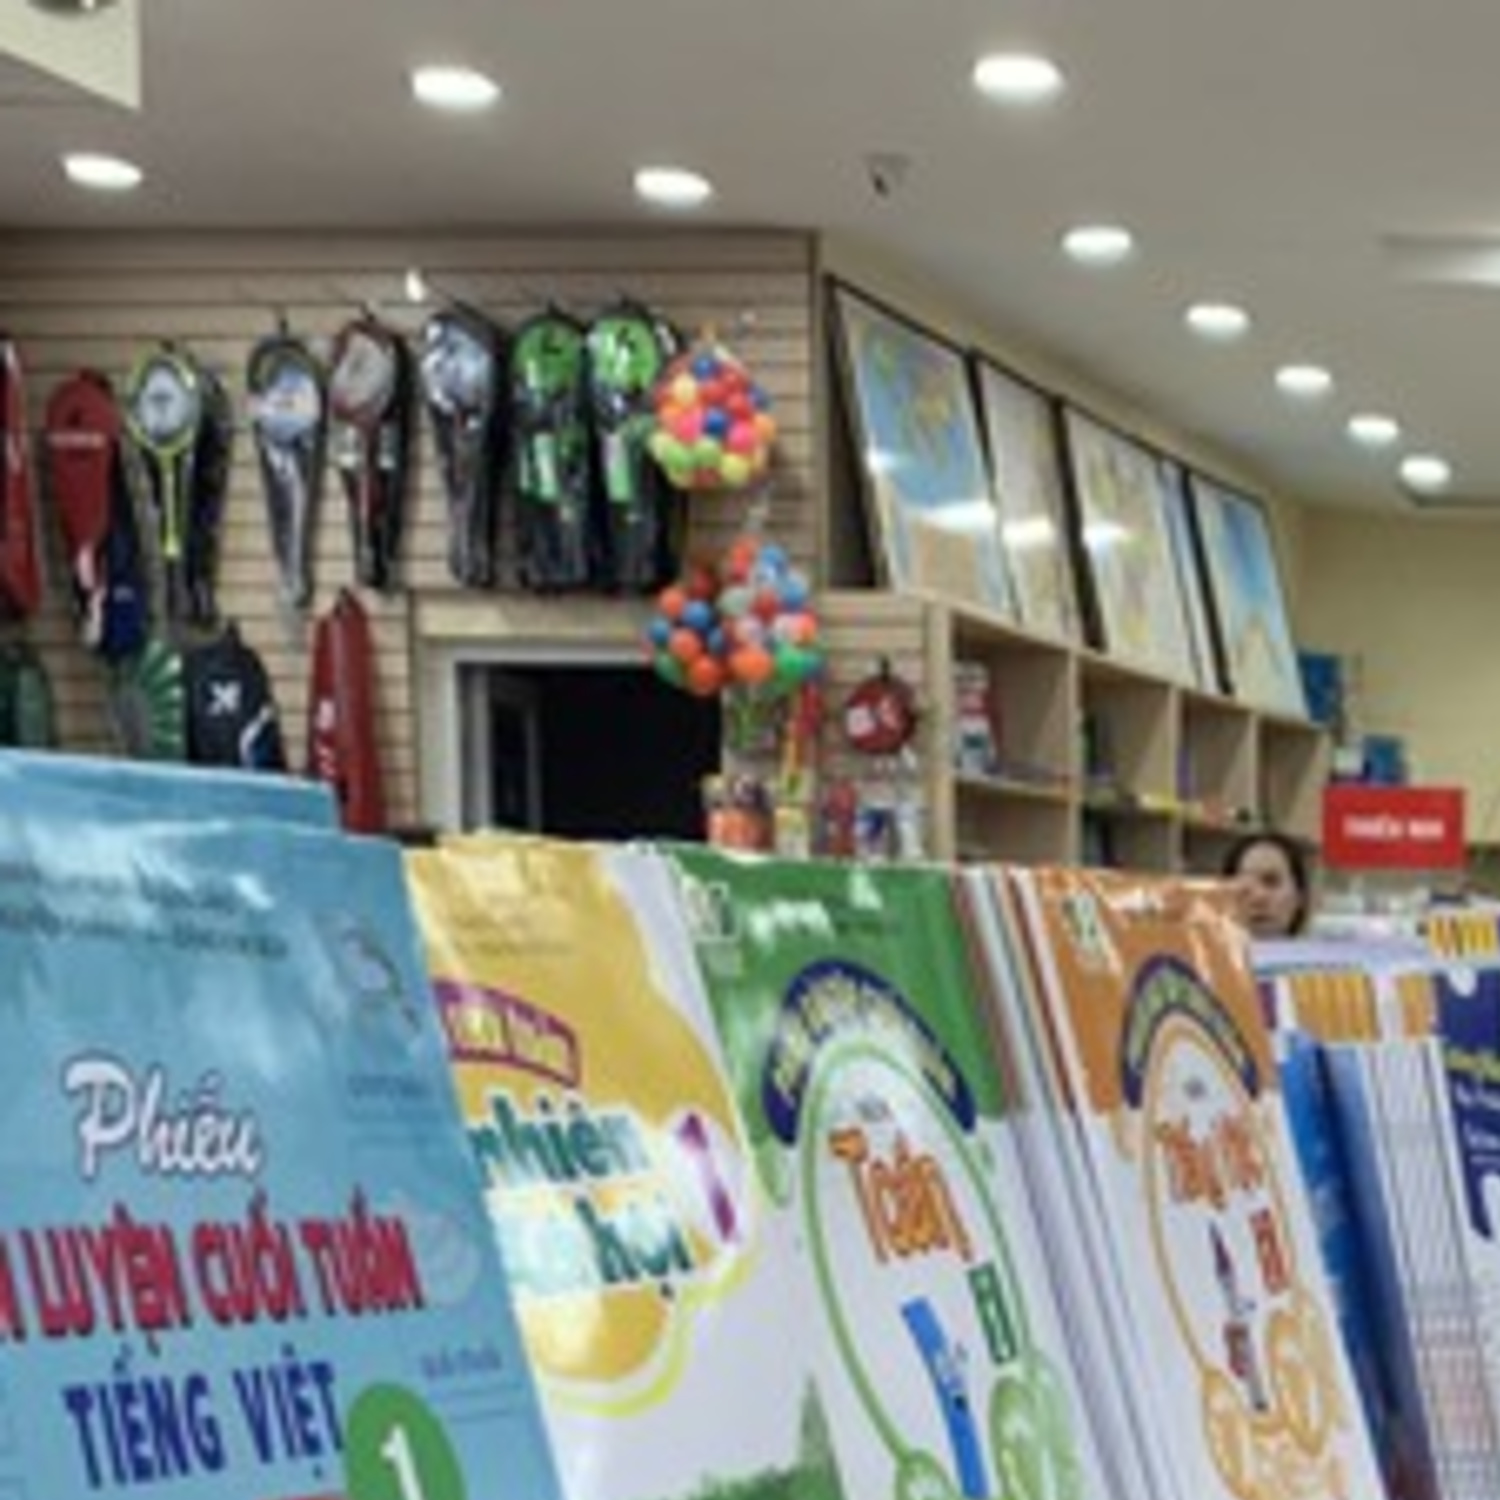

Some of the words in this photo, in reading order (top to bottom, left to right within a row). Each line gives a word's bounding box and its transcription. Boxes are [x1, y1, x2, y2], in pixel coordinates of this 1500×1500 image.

[60, 1050, 265, 1182] Phiếu
[20, 1200, 195, 1358] LUYỆN
[192, 1184, 308, 1328] CUỐI
[62, 1341, 228, 1492] TIẾNG
[232, 1342, 346, 1480] VIỆT
